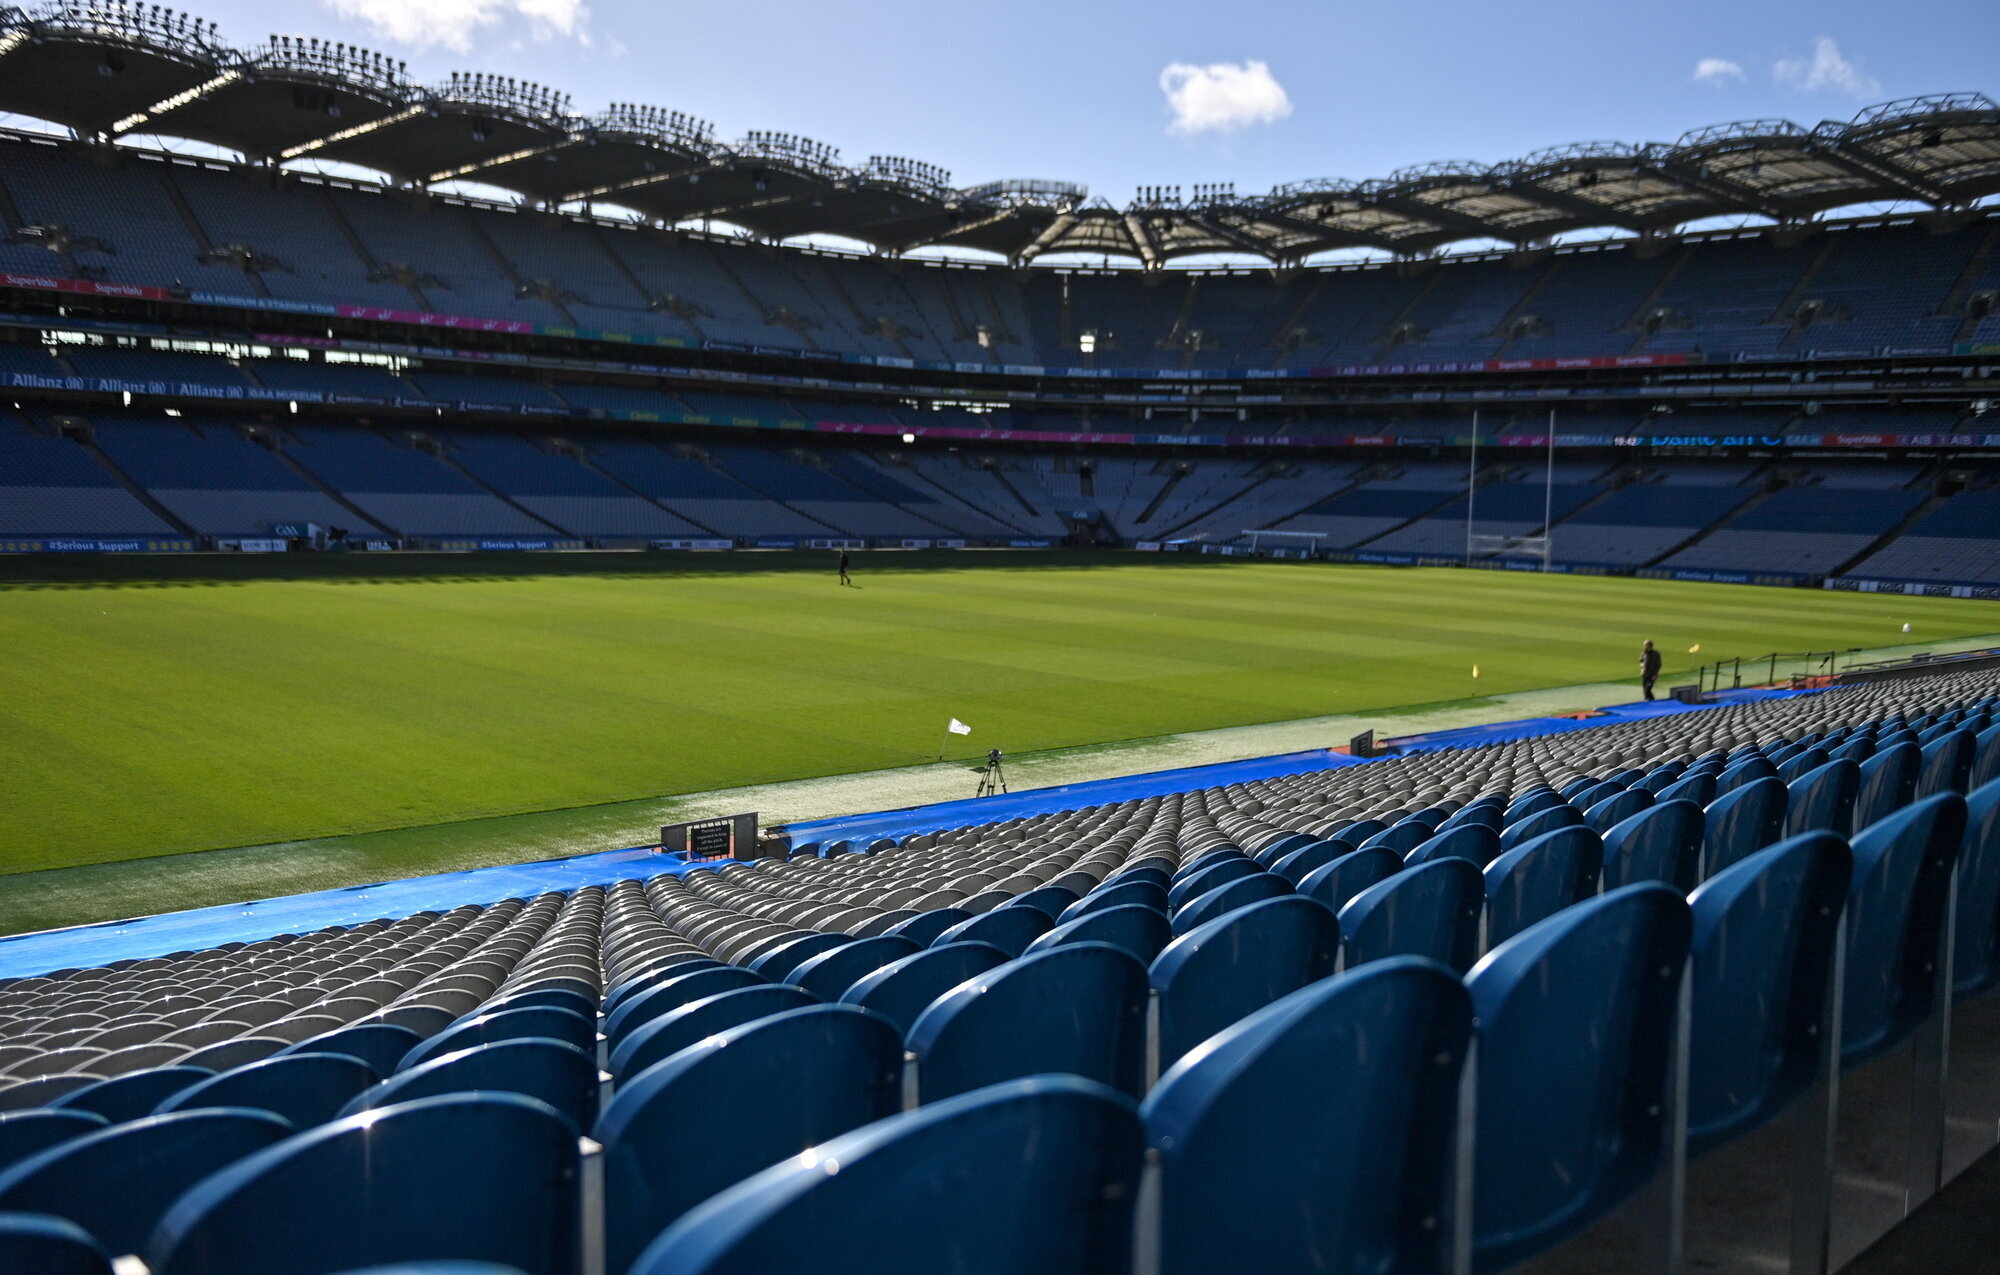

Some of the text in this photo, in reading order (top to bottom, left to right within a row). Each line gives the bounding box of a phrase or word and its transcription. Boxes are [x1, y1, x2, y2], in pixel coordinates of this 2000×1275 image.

[6, 274, 58, 288] SuperValu
[95, 282, 143, 296] SuperValu
[191, 293, 213, 304] GAA
[215, 295, 257, 307] MUSEUM
[267, 299, 309, 311] STADIUM
[311, 303, 336, 314] TOUR
[1067, 367, 1098, 377] Allianz
[1158, 369, 1191, 379] Allianz
[1246, 368, 1275, 378] Allianz
[12, 373, 63, 389] Allianz
[99, 378, 146, 393] Allianz
[179, 383, 224, 398] Allianz
[250, 388, 274, 399] GAA
[276, 390, 323, 401] MUSEUM
[1157, 434, 1188, 444] Allianz
[1911, 434, 1932, 445] AIB
[1950, 434, 1973, 445] AIB
[275, 525, 299, 536] GAA
[50, 541, 140, 552] #Serious Support
[482, 541, 547, 550] #Serious Support
